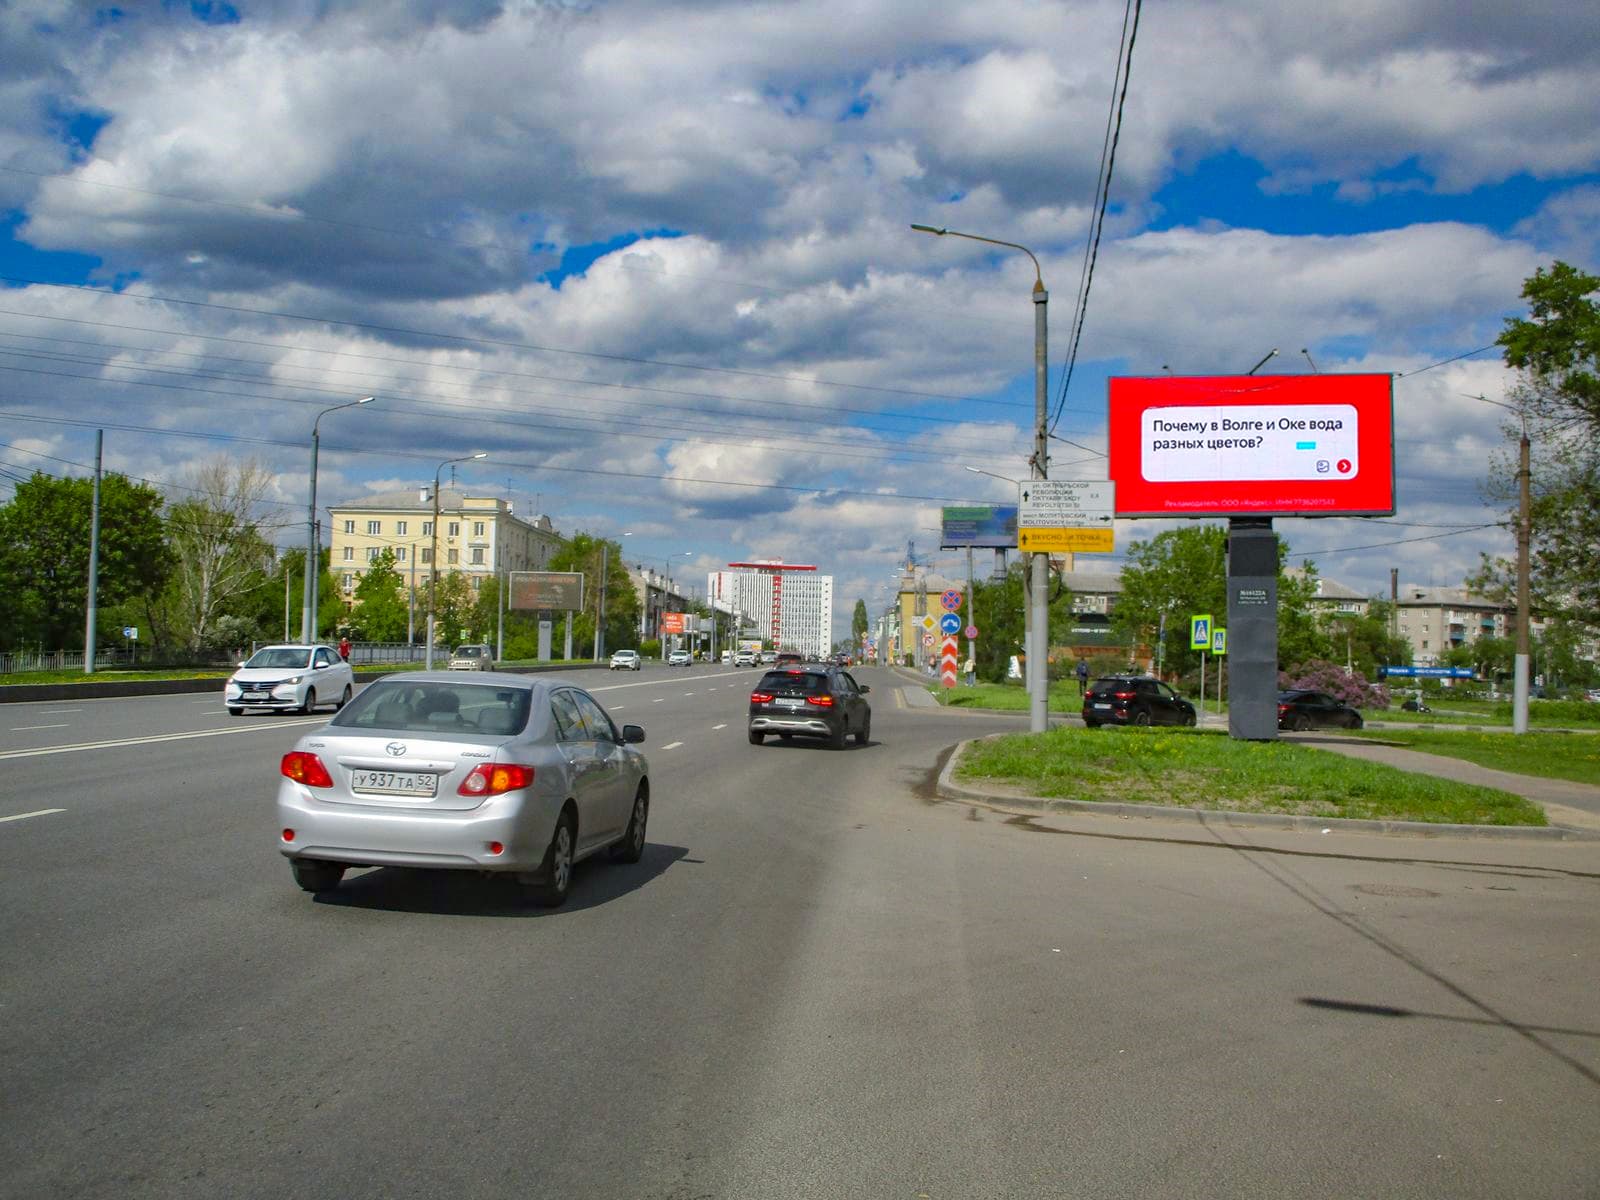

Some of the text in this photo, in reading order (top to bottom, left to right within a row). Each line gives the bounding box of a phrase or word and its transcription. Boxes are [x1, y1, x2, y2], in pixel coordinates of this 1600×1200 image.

[1153, 417, 1343, 435] Почему в Волге и Оке вода
[1153, 436, 1264, 452] разных цветов?
[1221, 498, 1239, 506] ООО
